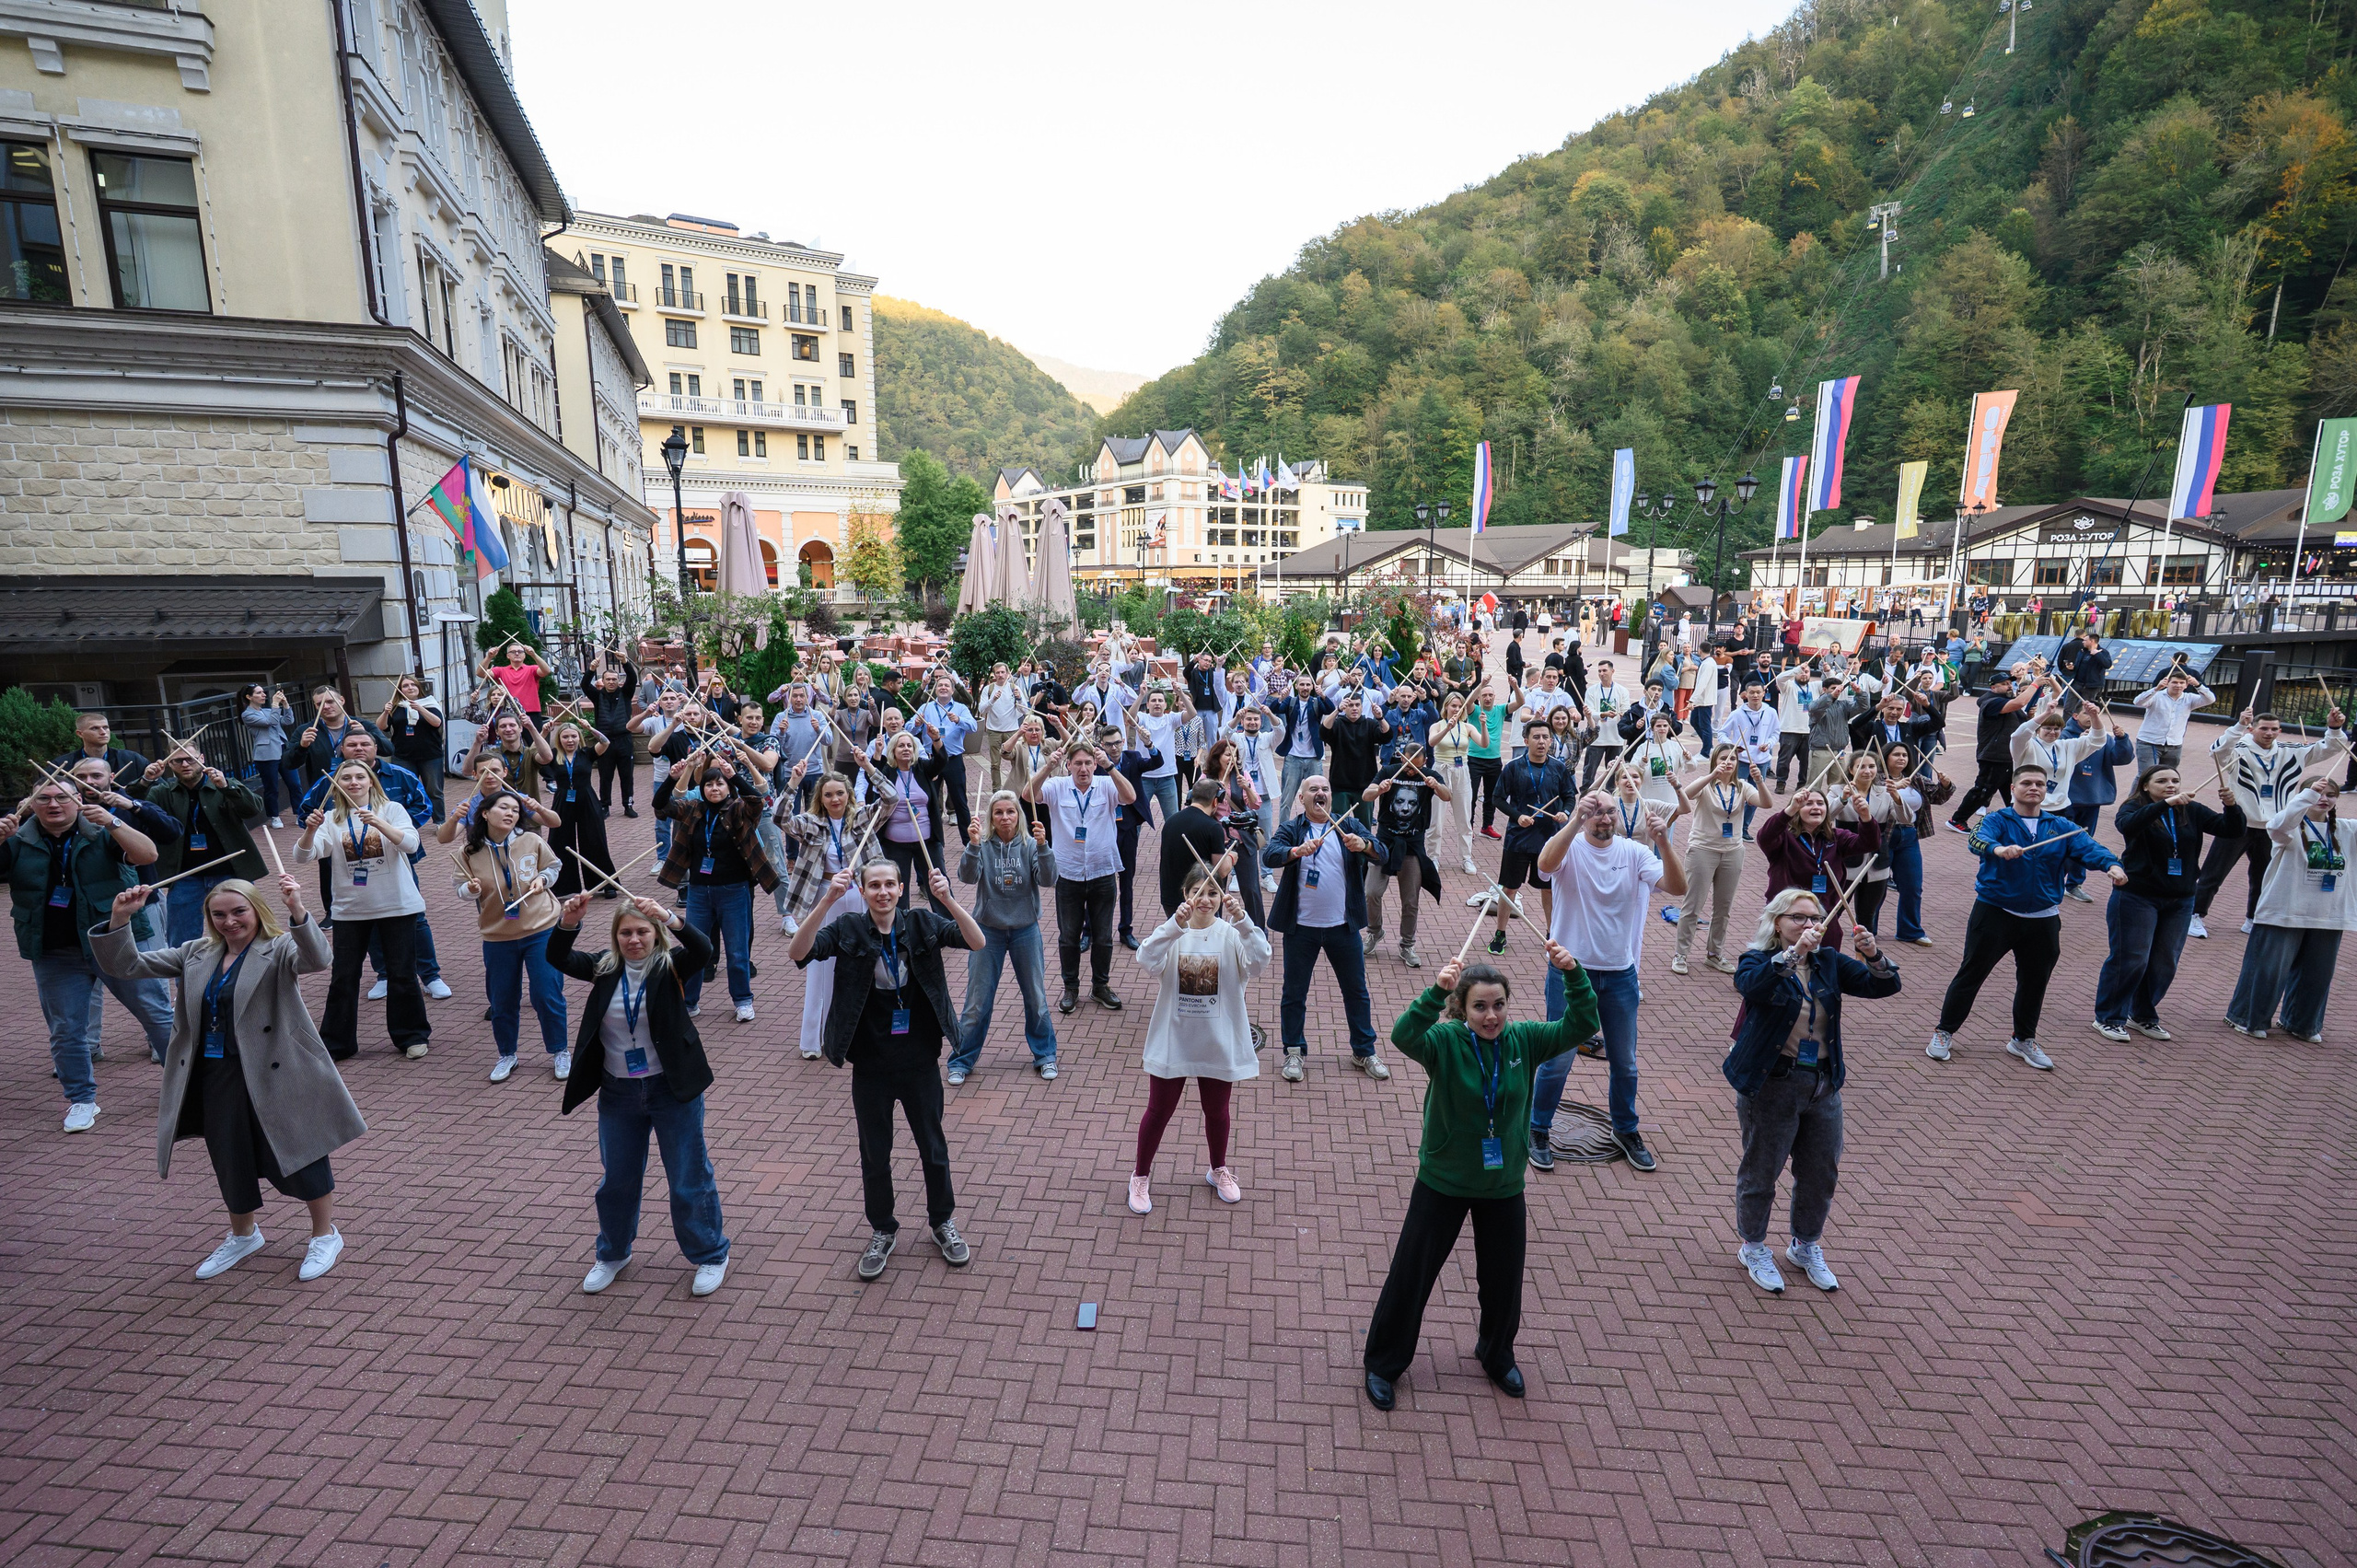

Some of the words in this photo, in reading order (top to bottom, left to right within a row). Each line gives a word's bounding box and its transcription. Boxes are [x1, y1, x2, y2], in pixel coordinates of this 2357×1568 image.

[2335, 429, 2351, 463] ХУТОР
[2330, 463, 2344, 490] РОЗА
[2050, 534, 2076, 542] РОЗА
[2079, 532, 2115, 541] ХУТОР
[519, 854, 536, 882] S
[994, 857, 1021, 868] LISBOA
[1014, 876, 1023, 885] 48
